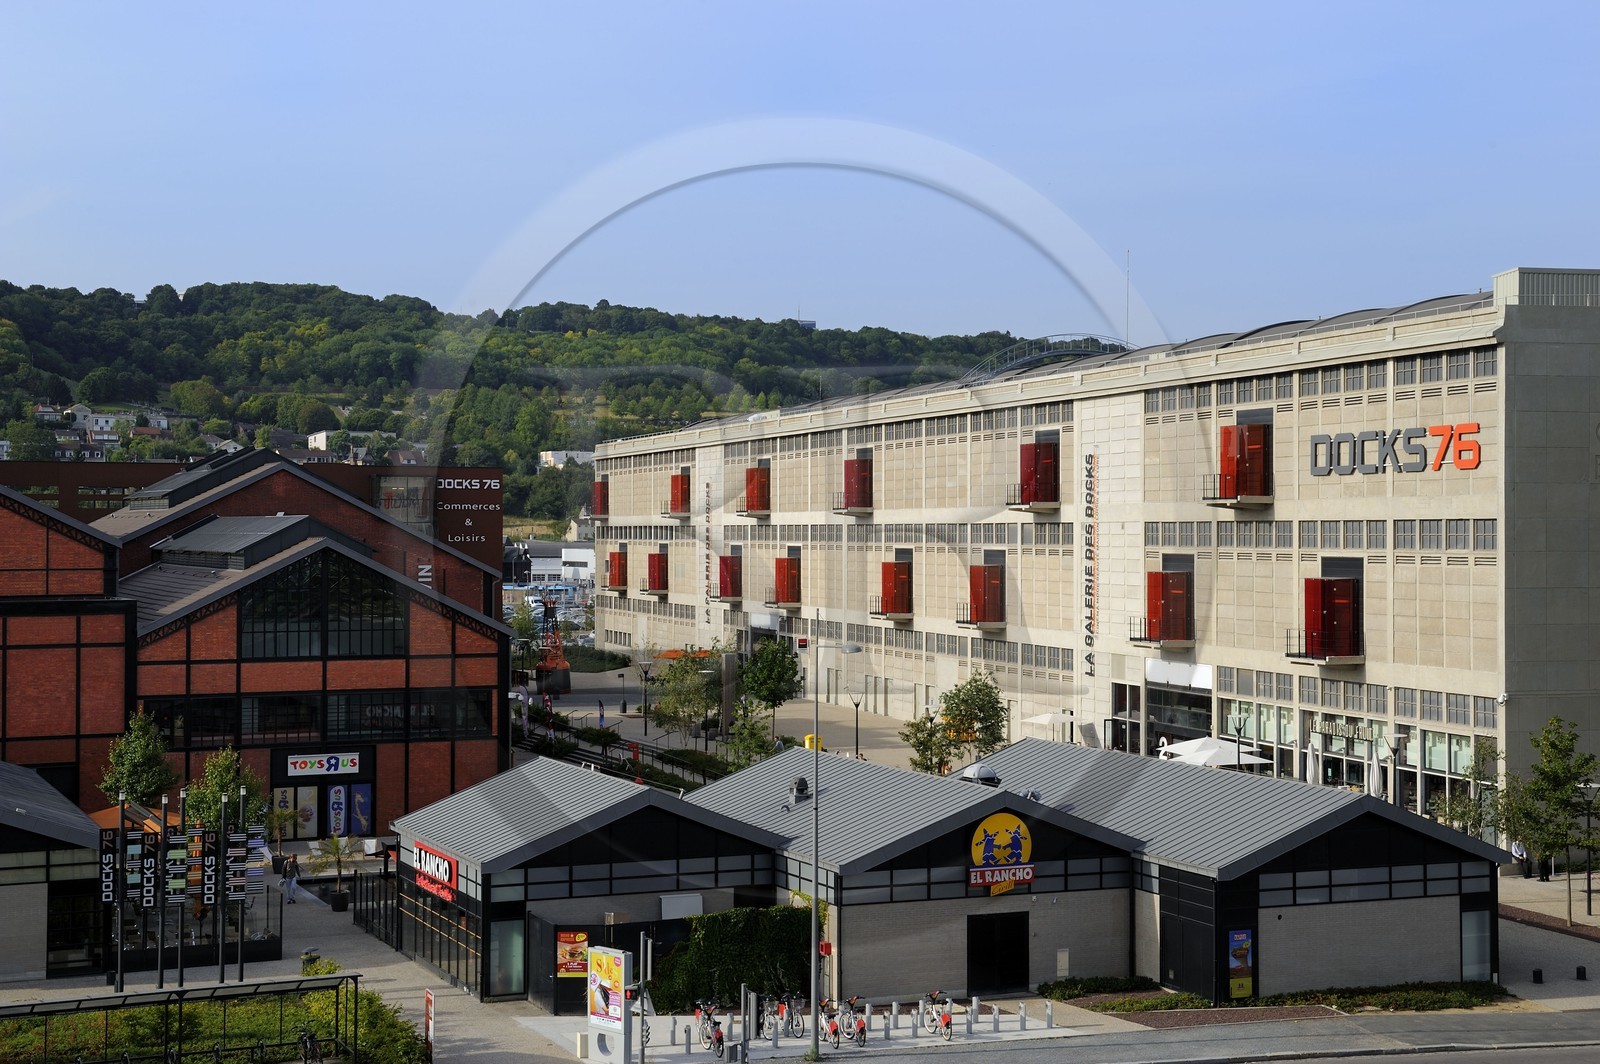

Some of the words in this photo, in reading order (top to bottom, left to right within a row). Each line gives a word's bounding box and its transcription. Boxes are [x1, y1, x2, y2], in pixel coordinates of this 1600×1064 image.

[483, 479, 500, 489] 76
[1085, 453, 1095, 518] DOCKS
[437, 502, 501, 511] Commerces
[464, 518, 473, 526] &
[448, 534, 486, 542] Loisirs
[1085, 523, 1095, 561] DES
[1085, 565, 1095, 647] GALERIE
[1085, 652, 1095, 677] LA
[102, 830, 113, 849] 76
[144, 834, 155, 853] 76
[205, 832, 216, 851] 76
[414, 847, 421, 870] EL
[421, 850, 449, 882] RANCHO
[102, 854, 113, 902] DOCKS
[143, 858, 155, 907] DOCKS
[204, 856, 215, 904] DOCKS
[970, 872, 983, 884] EL
[985, 867, 1033, 883] RANCHO
[991, 880, 1014, 895] Grill
